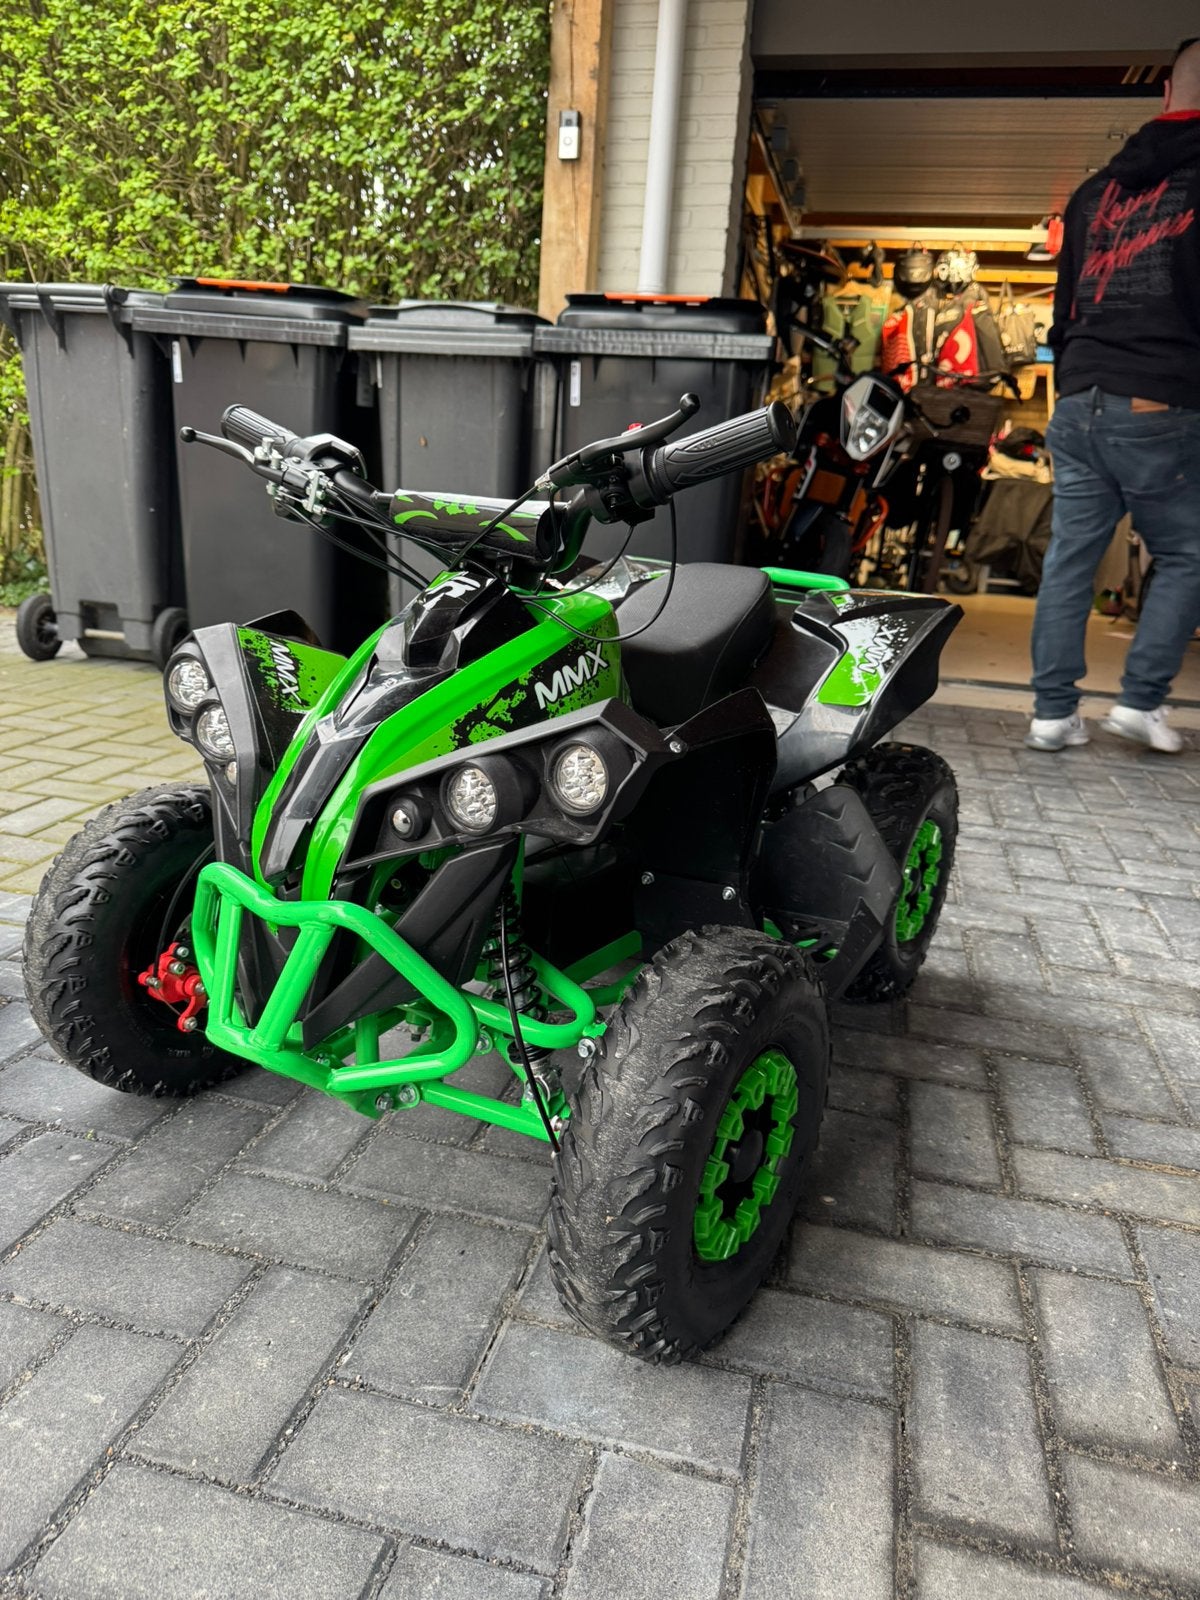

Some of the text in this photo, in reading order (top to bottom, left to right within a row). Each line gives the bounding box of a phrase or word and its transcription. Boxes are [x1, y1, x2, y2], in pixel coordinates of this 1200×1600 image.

[269, 641, 302, 704] MMX
[534, 642, 609, 710] MMX
[857, 625, 900, 675] MMX
